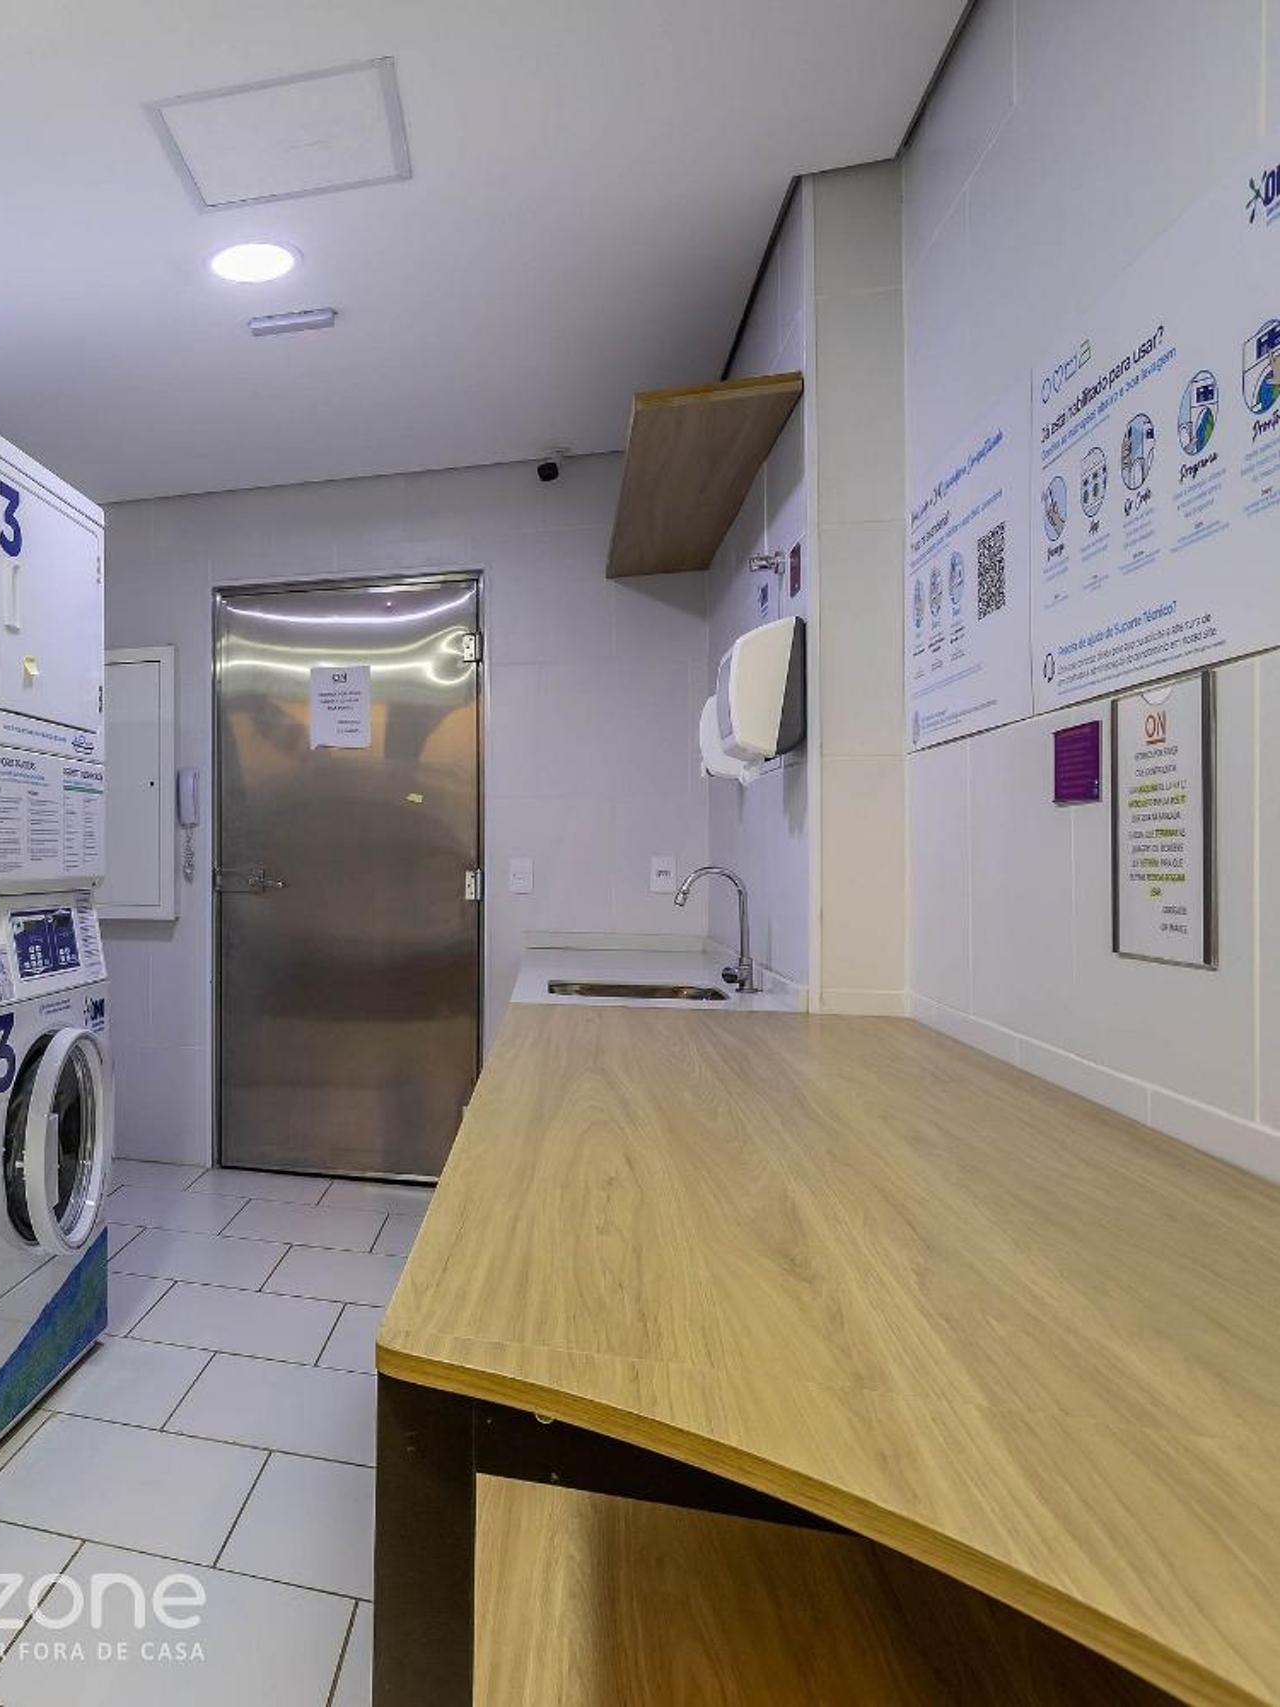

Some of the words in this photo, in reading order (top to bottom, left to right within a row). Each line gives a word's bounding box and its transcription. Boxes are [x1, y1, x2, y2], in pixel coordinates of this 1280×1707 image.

[1108, 356, 1131, 389] para
[1132, 325, 1164, 363] usar?
[1114, 616, 1143, 634] Suporte
[1144, 710, 1167, 738] ON
